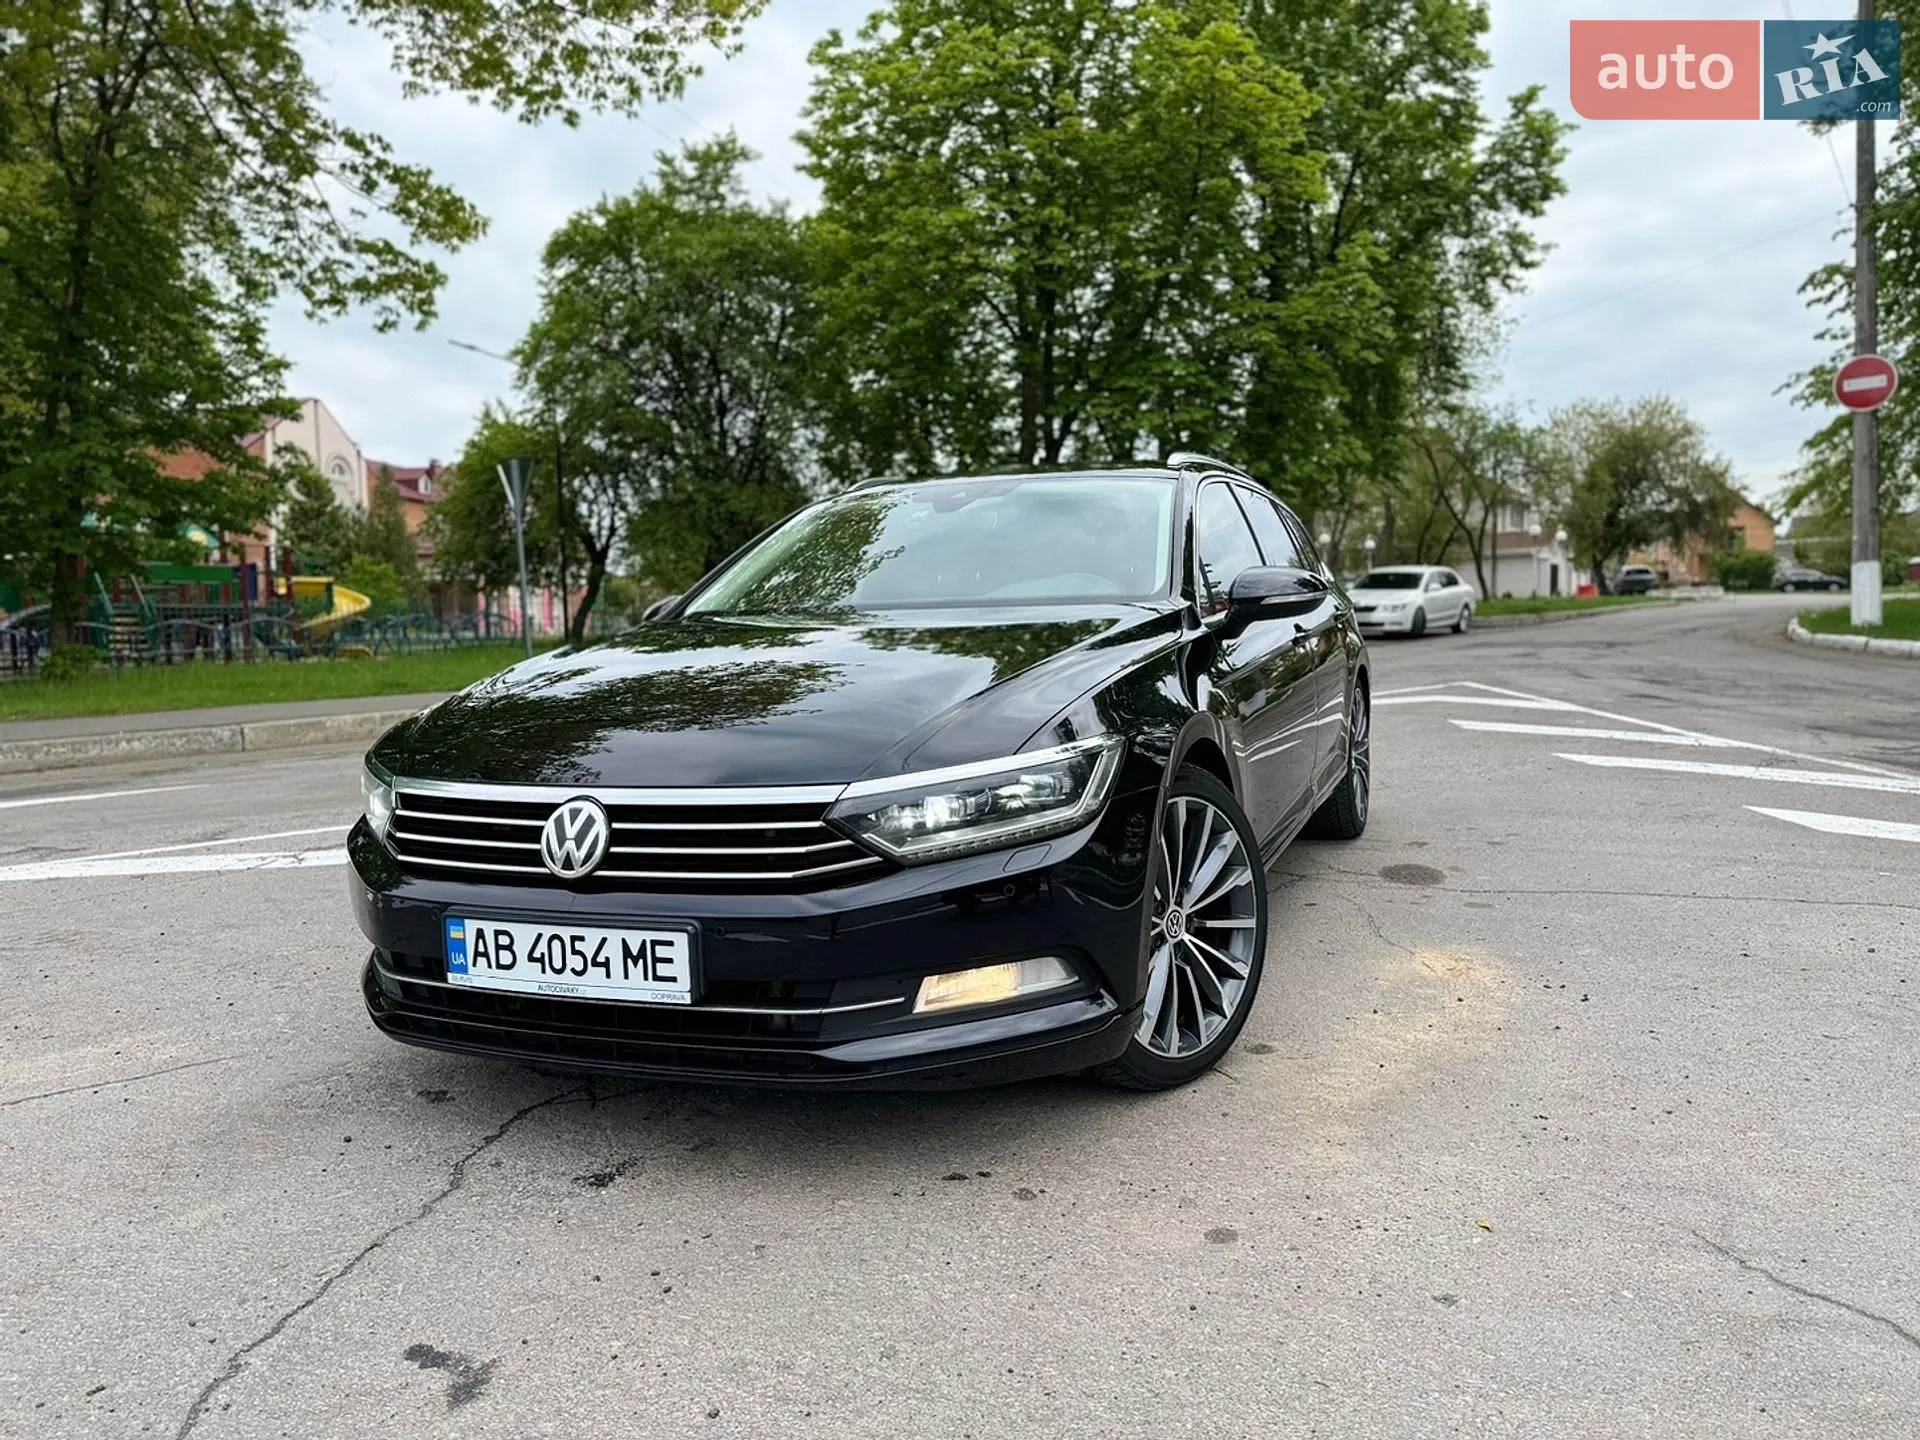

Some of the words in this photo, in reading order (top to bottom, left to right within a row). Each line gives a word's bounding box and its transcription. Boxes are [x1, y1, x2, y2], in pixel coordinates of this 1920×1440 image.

[451, 952, 467, 966] UA
[472, 928, 517, 971] AB
[527, 932, 611, 979] 4054
[621, 937, 678, 983] ME
